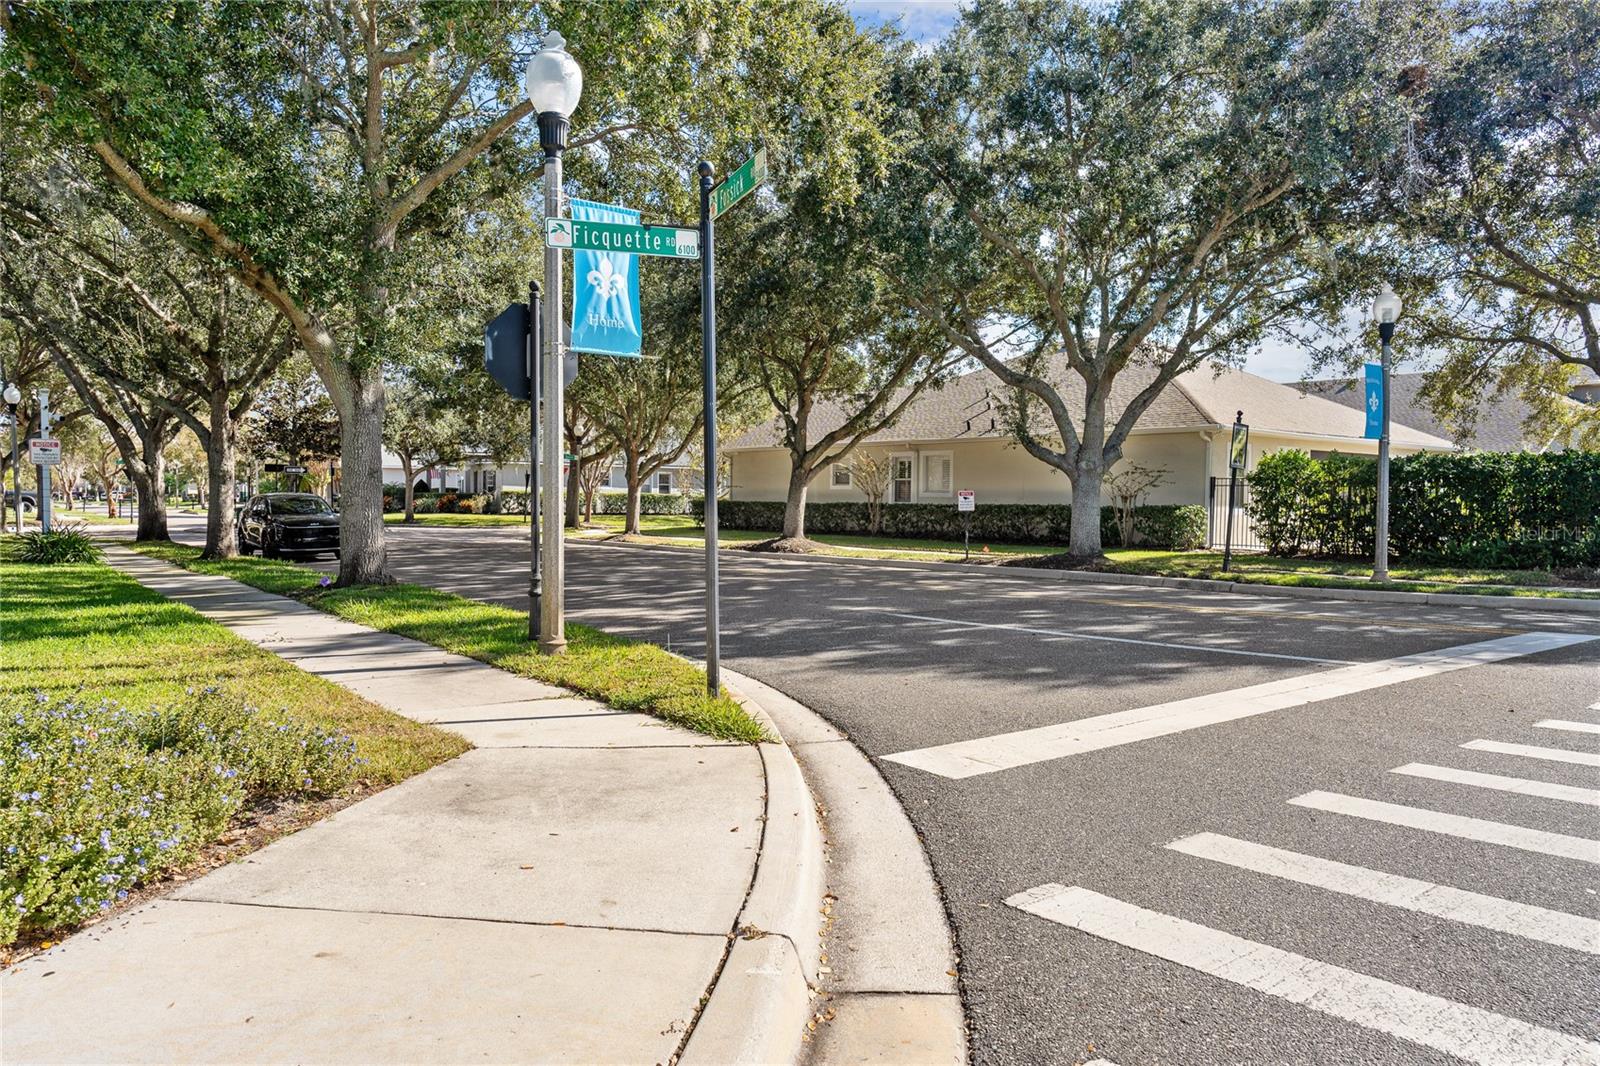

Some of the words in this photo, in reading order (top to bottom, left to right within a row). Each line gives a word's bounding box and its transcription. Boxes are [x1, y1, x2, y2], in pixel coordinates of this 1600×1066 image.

[573, 225, 661, 250] Ficquette
[665, 236, 676, 247] RD
[677, 244, 696, 255] 6100
[588, 312, 625, 329] Home
